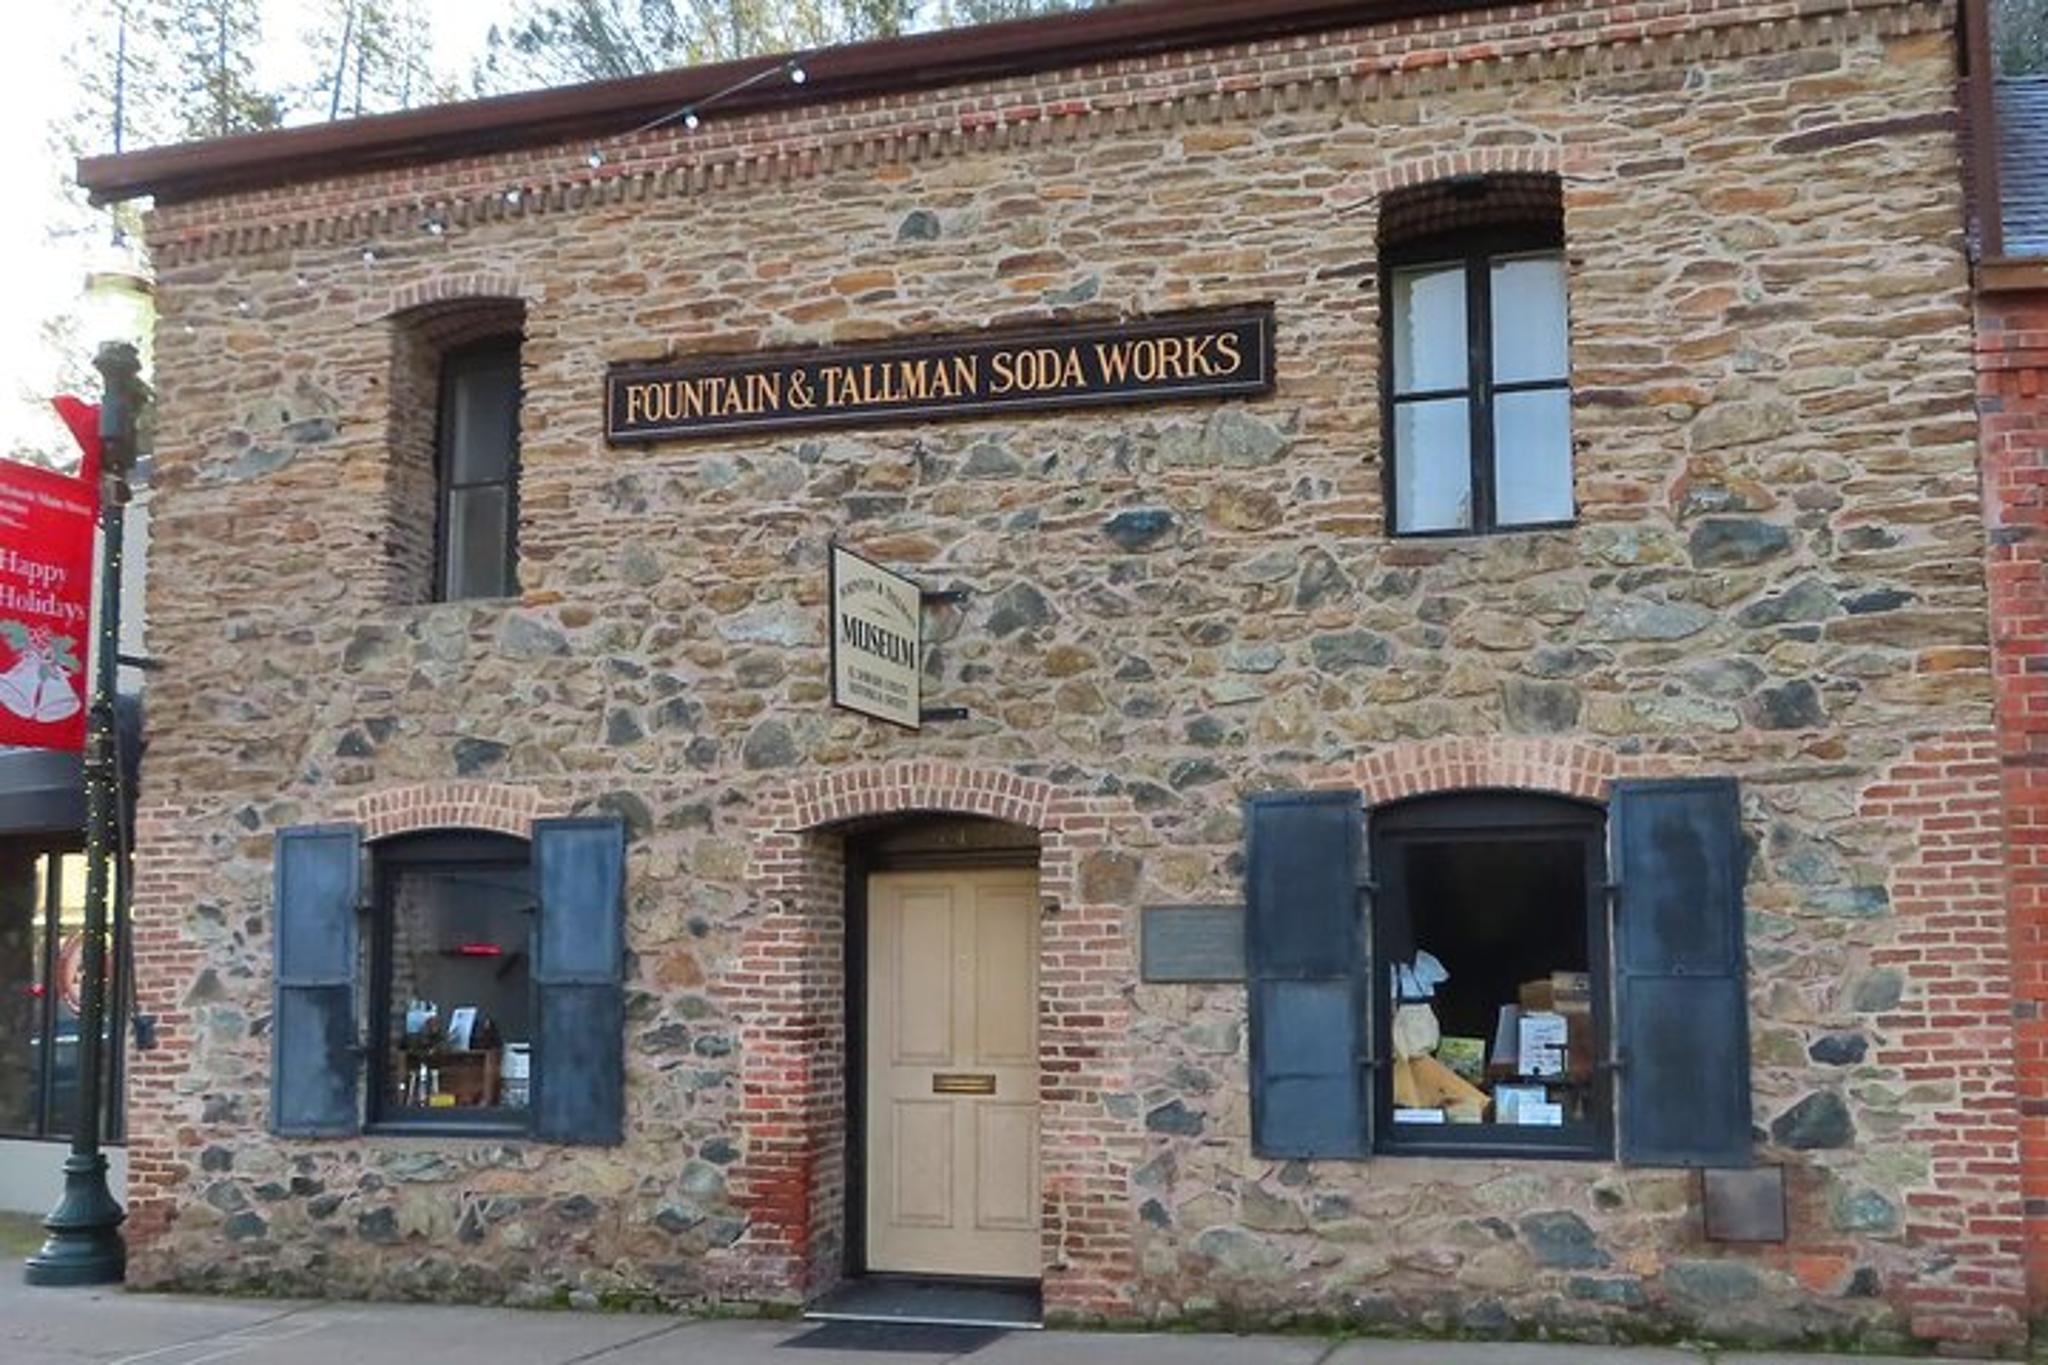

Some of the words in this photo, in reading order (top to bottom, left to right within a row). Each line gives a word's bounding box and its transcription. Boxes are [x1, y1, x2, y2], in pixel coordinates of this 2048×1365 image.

[626, 372, 780, 424] FOUNTAIN
[787, 368, 816, 410] &
[820, 354, 977, 407] TALLMAN
[990, 347, 1087, 393] SODA
[1095, 332, 1241, 385] WORKS
[0, 548, 67, 590] Happy
[0, 583, 86, 627] Holidays
[841, 614, 915, 670] MUSEUM
